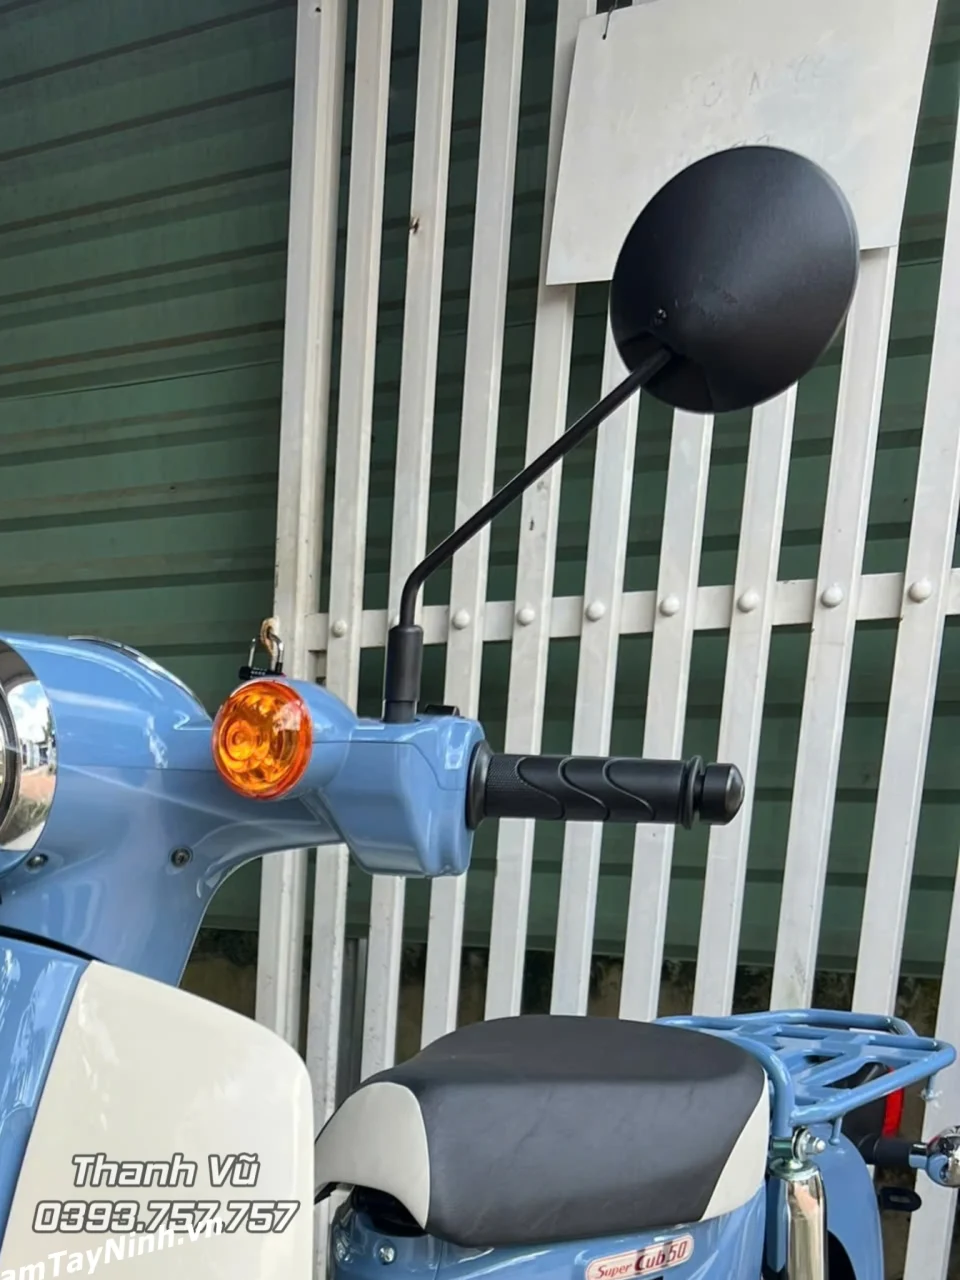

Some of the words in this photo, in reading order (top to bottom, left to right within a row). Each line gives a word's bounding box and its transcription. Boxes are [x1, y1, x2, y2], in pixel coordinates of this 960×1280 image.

[595, 1263, 632, 1279] Super
[635, 1250, 666, 1272] Cub
[667, 1241, 688, 1260] 50
